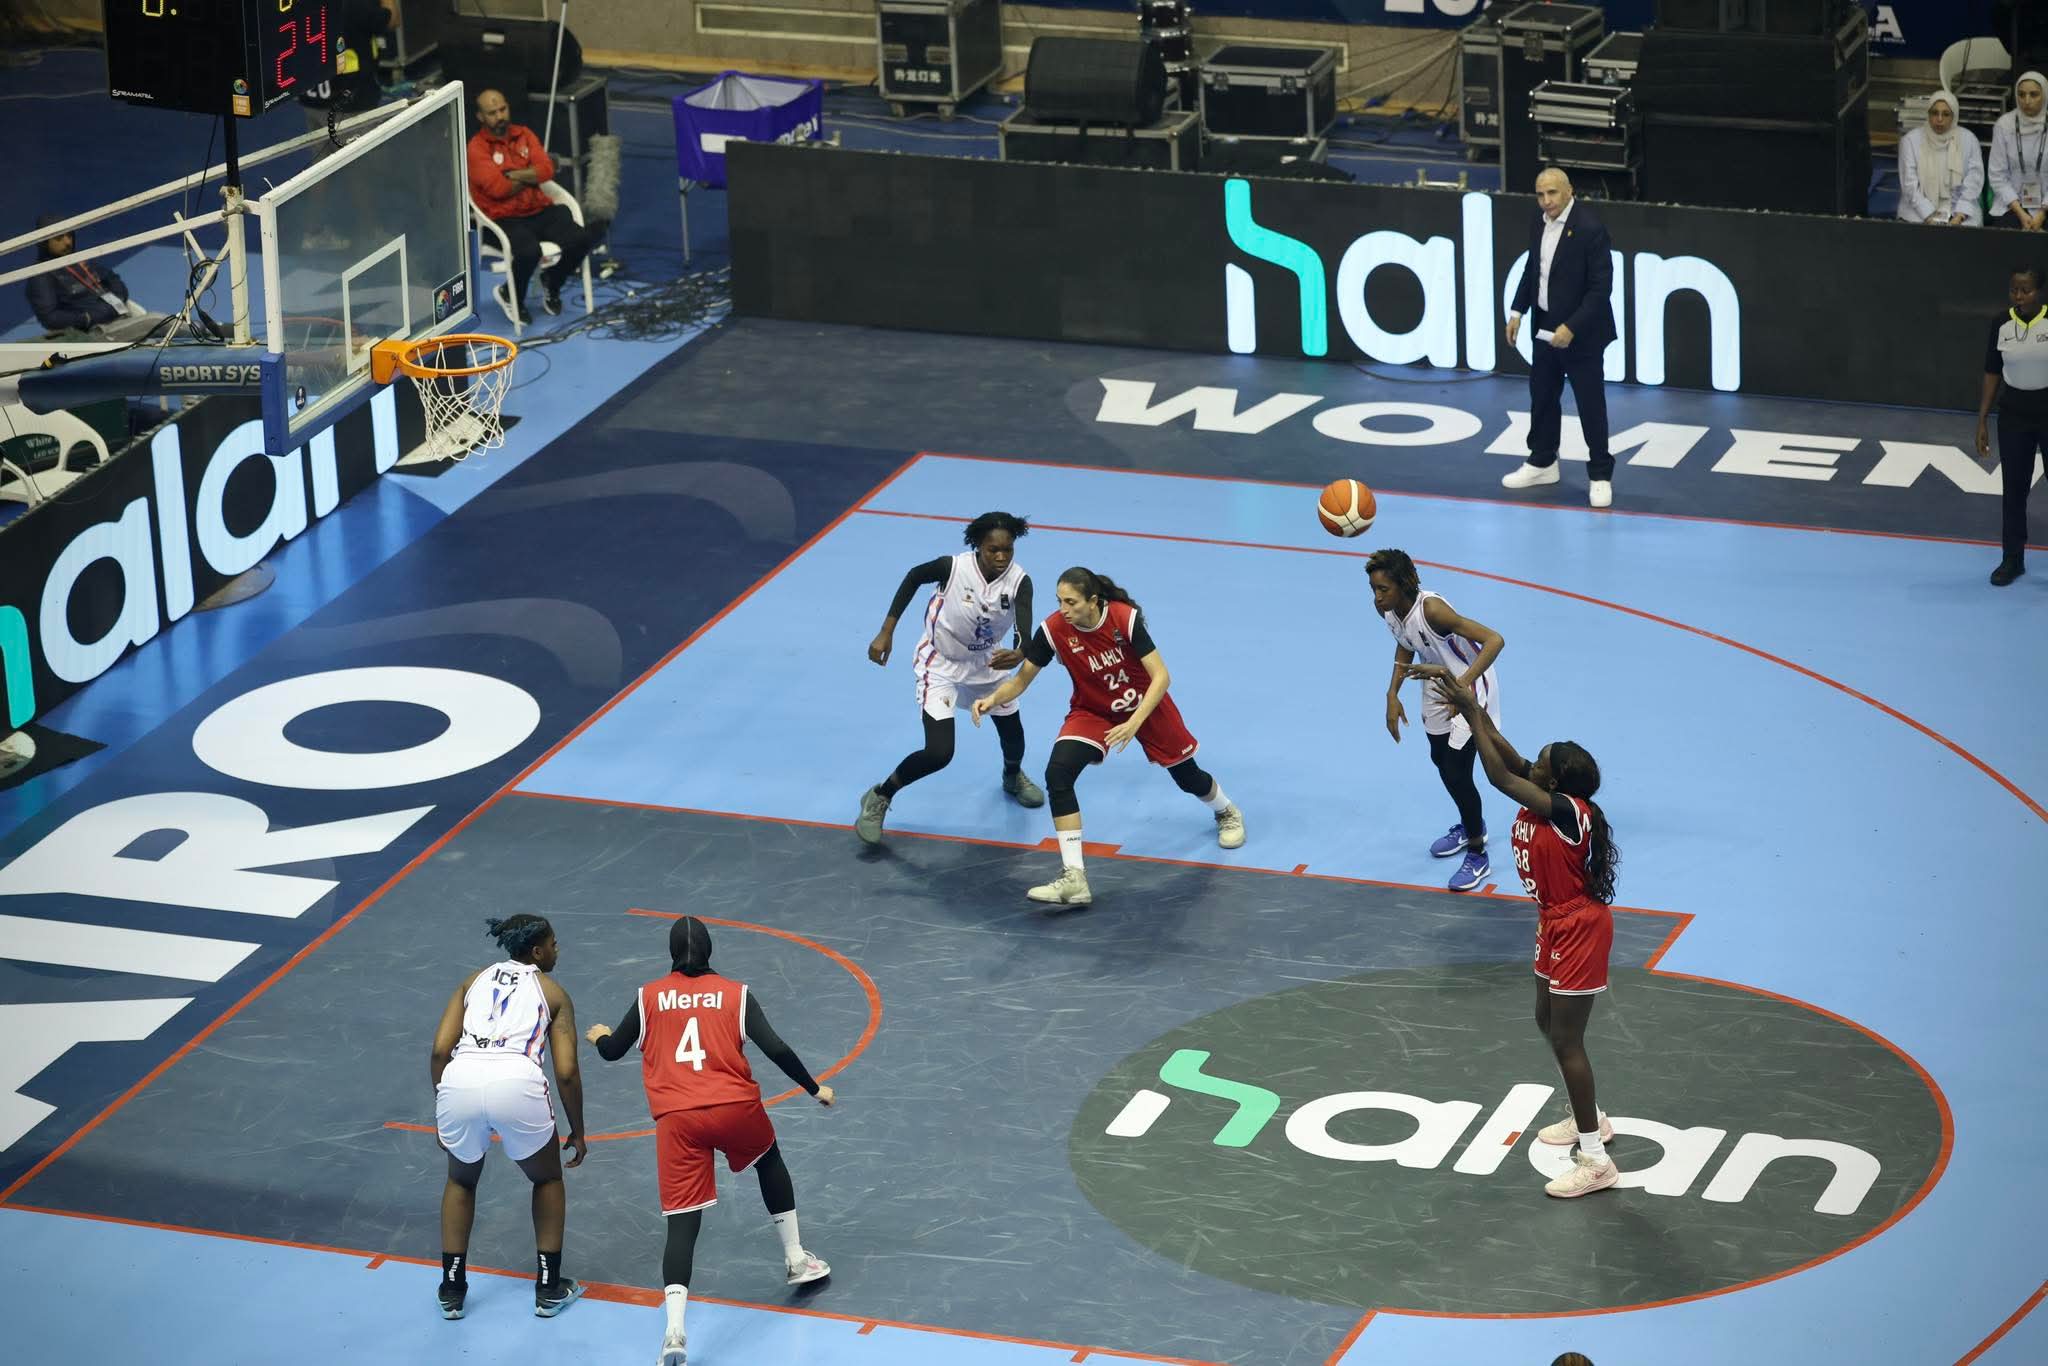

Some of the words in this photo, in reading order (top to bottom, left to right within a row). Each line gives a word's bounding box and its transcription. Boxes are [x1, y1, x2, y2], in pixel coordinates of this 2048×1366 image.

[276, 6, 327, 88] 24
[1100, 646, 1125, 667] AHLY
[1103, 668, 1130, 691] 24
[658, 989, 723, 1012] Meral
[675, 1016, 707, 1072] 4
[1105, 1049, 1881, 1215] halan
